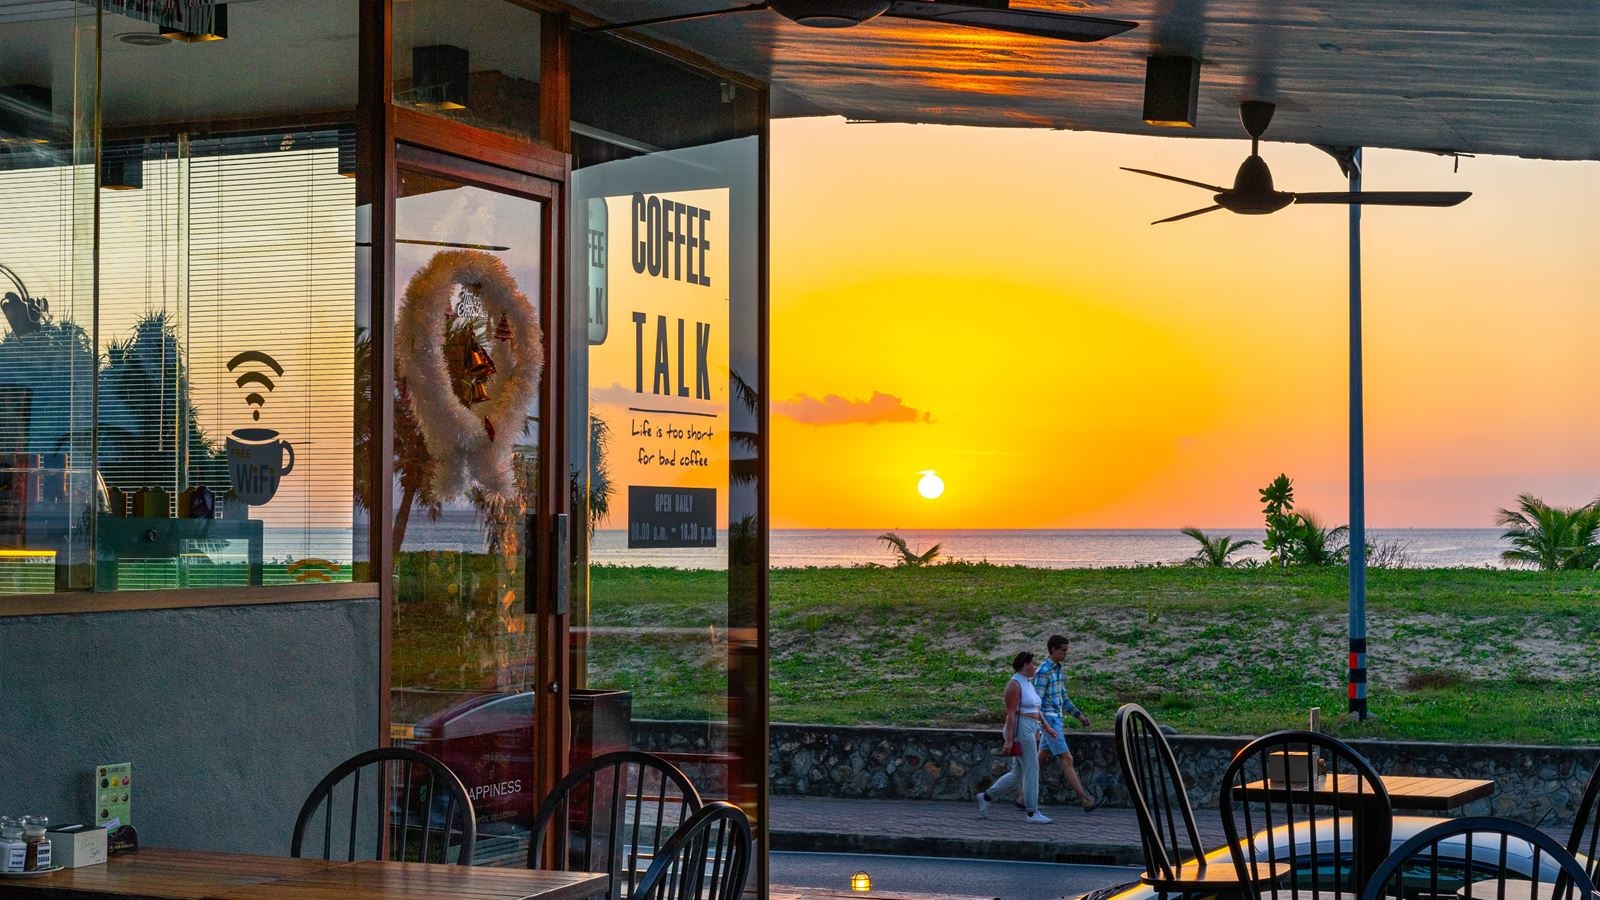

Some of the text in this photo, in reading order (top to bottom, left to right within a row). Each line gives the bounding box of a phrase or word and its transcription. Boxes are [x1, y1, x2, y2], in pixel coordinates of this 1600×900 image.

[632, 191, 711, 287] COFFEE
[632, 311, 711, 400] TALK
[631, 419, 714, 441] Life is too short
[637, 447, 708, 467] for bad coffee
[655, 493, 694, 513] OPEN DAILY
[468, 779, 522, 801] APPINESS
